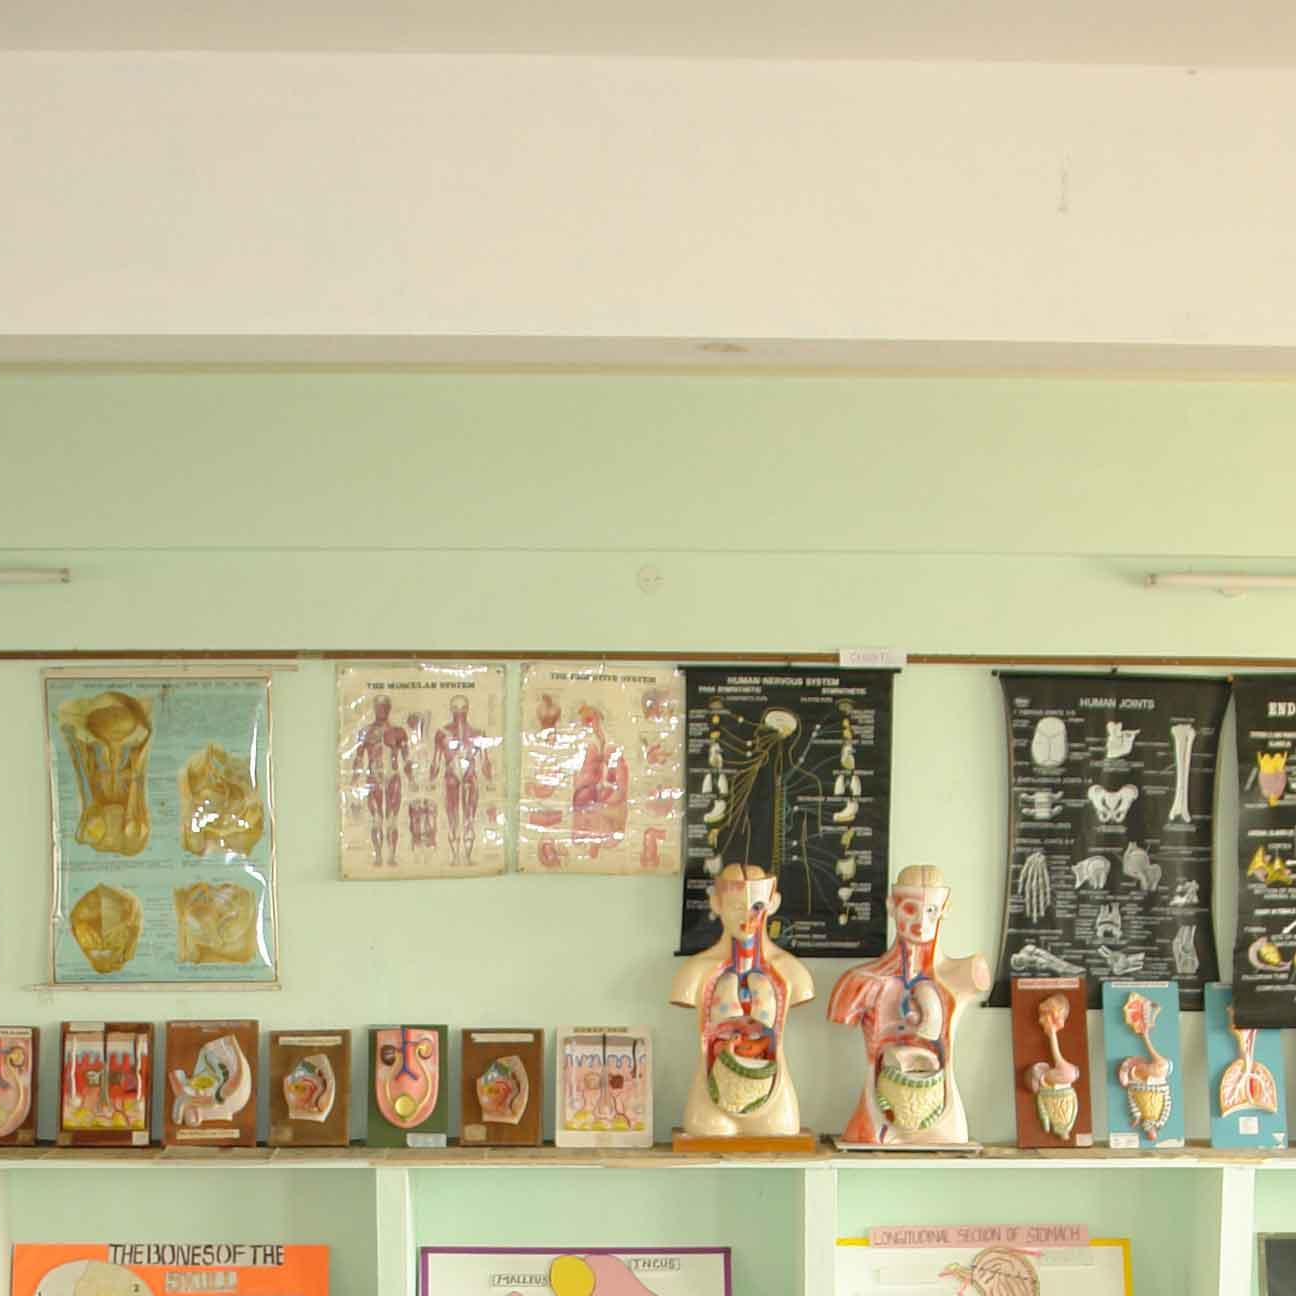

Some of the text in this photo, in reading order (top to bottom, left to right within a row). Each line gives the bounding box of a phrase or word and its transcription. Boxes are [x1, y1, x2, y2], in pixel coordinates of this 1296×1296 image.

[727, 676, 760, 685] HUMAN
[806, 678, 840, 686] SYSTEM
[1080, 698, 1155, 709] HUMAN JOINTS
[1005, 1226, 1018, 1242] OF
[1025, 1224, 1081, 1244] STOMACH
[109, 1244, 284, 1266] THE BONES OF THE
